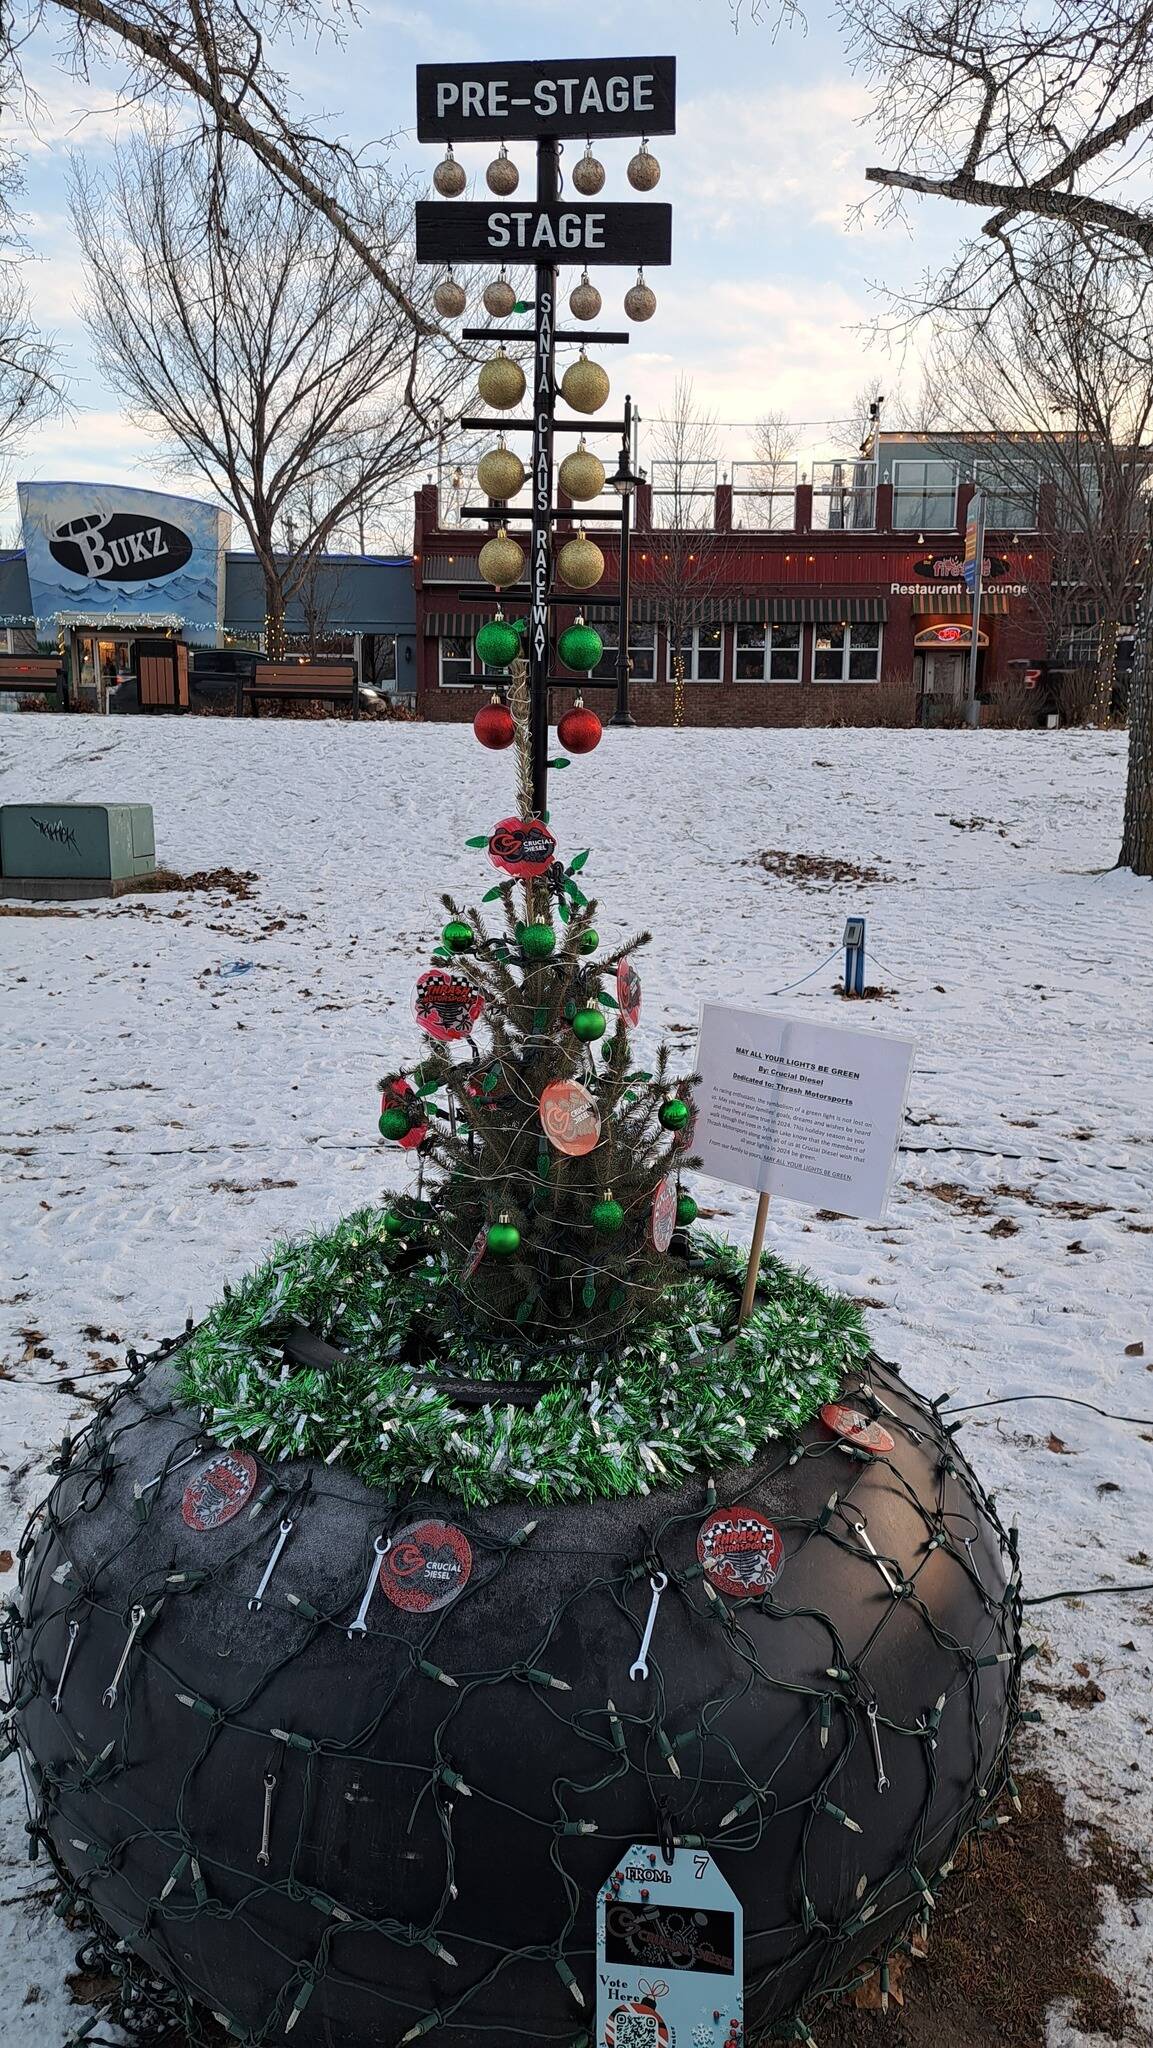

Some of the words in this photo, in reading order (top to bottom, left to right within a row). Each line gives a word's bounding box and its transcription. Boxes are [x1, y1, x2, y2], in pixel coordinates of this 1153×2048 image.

[437, 75, 654, 117] PRE-STAGE
[487, 212, 606, 248] STAGE
[538, 293, 551, 394] SANTA
[536, 413, 549, 511] CLAUS
[533, 529, 548, 662] RACEWAY
[890, 583, 962, 595] Restaurant
[980, 583, 1028, 597] Lounge
[523, 838, 554, 847] CRUCIAL
[735, 1047, 748, 1056] MAY
[750, 1050, 762, 1058] ALL
[764, 1053, 784, 1063] YOUR
[786, 1058, 815, 1070] LIGHTS
[817, 1064, 828, 1072] BE
[831, 1067, 859, 1079] GREEN
[758, 1065, 768, 1074] By:
[770, 1068, 797, 1079] Crucial
[799, 1074, 823, 1085] Diesel
[733, 1072, 763, 1085] Dedicated
[776, 1083, 802, 1094] Thrash
[804, 1089, 853, 1106] Motorsports
[805, 1109, 821, 1117] green
[822, 1112, 835, 1120] light
[792, 1114, 812, 1124] dreams
[825, 1122, 844, 1131] wishes
[853, 1128, 871, 1136] heard
[793, 1123, 803, 1131] This
[804, 1126, 824, 1136] holiday
[826, 1132, 845, 1140] season
[779, 1129, 791, 1137] Lake
[792, 1132, 807, 1141] know
[831, 1141, 857, 1152] members
[801, 1143, 820, 1153] Crucial
[821, 1148, 838, 1157] Diesel
[839, 1152, 852, 1160] wish
[853, 1155, 865, 1163] that
[786, 1160, 802, 1168] YOUR
[803, 1164, 822, 1173] LIGHTS
[713, 1530, 764, 1545] THRASH
[424, 1570, 450, 1579] DIESEL
[426, 1562, 461, 1572] CRUCIAL
[626, 1867, 672, 1883] FROM:
[694, 1855, 709, 1879] 7
[599, 1975, 628, 1988] Vote
[608, 1988, 640, 2003] Here
